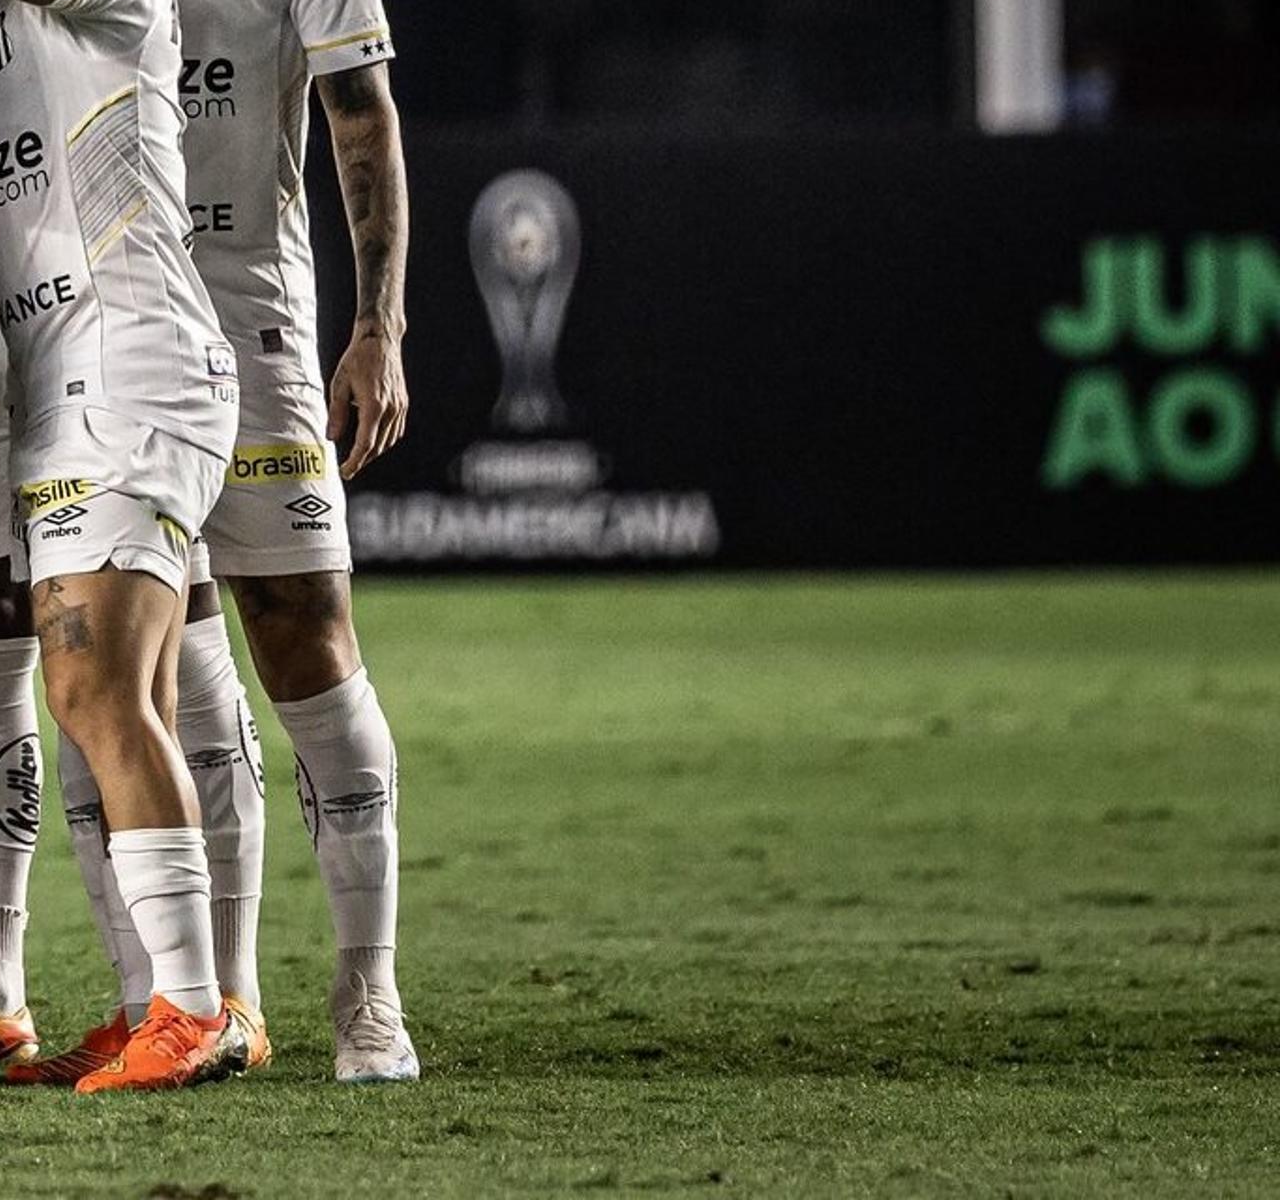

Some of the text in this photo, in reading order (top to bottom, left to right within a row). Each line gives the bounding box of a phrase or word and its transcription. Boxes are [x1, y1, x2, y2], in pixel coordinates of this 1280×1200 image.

[0, 274, 76, 330] ANCE
[234, 450, 321, 478] brasilit
[41, 526, 83, 540] umbro
[291, 521, 331, 531] umbro
